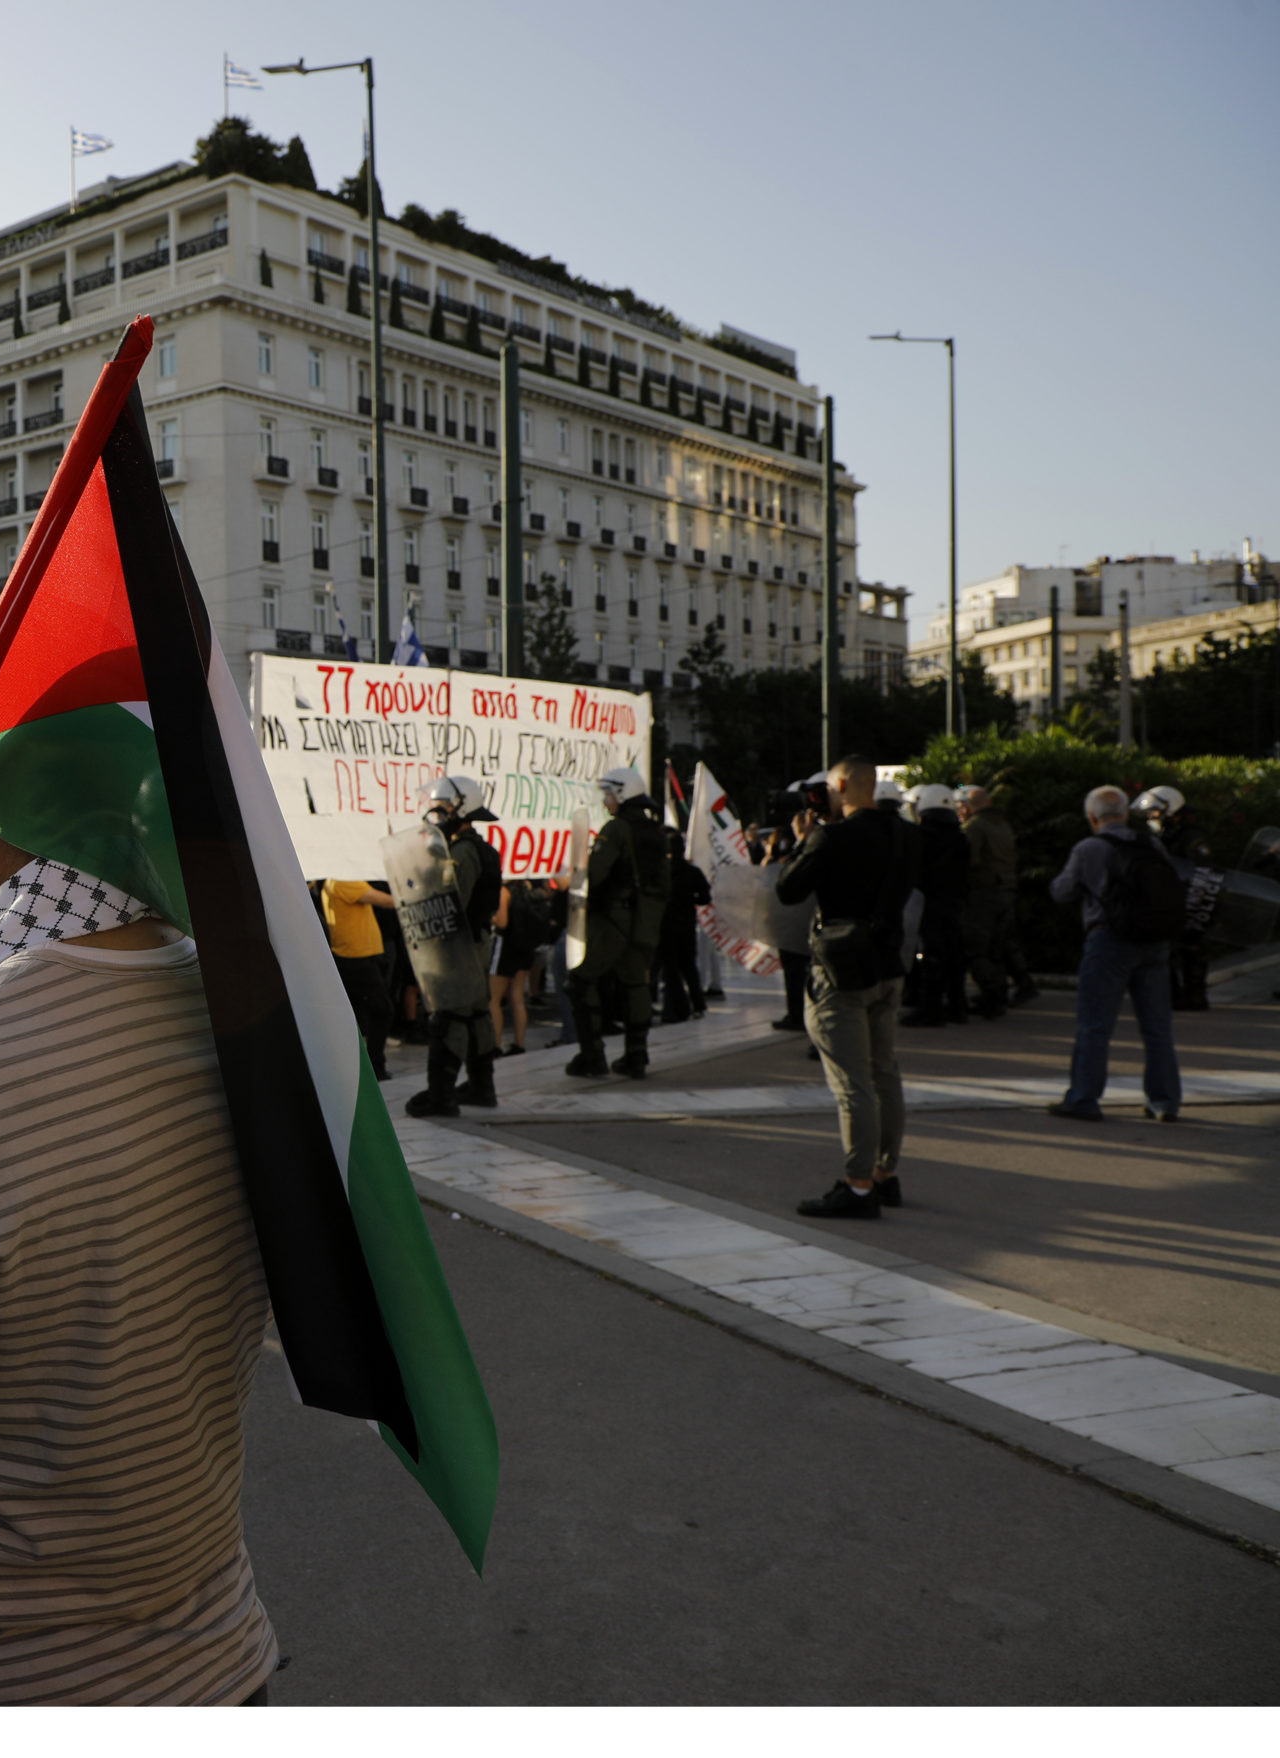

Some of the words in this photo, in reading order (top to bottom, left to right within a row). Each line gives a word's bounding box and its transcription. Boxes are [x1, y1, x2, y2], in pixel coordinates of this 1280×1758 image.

[316, 664, 355, 715] 77
[365, 671, 451, 722] χρόνια
[472, 683, 518, 720] από
[530, 694, 559, 724] τη
[297, 717, 421, 758] ΣΤΑΜΑΤΗΣΕΙ
